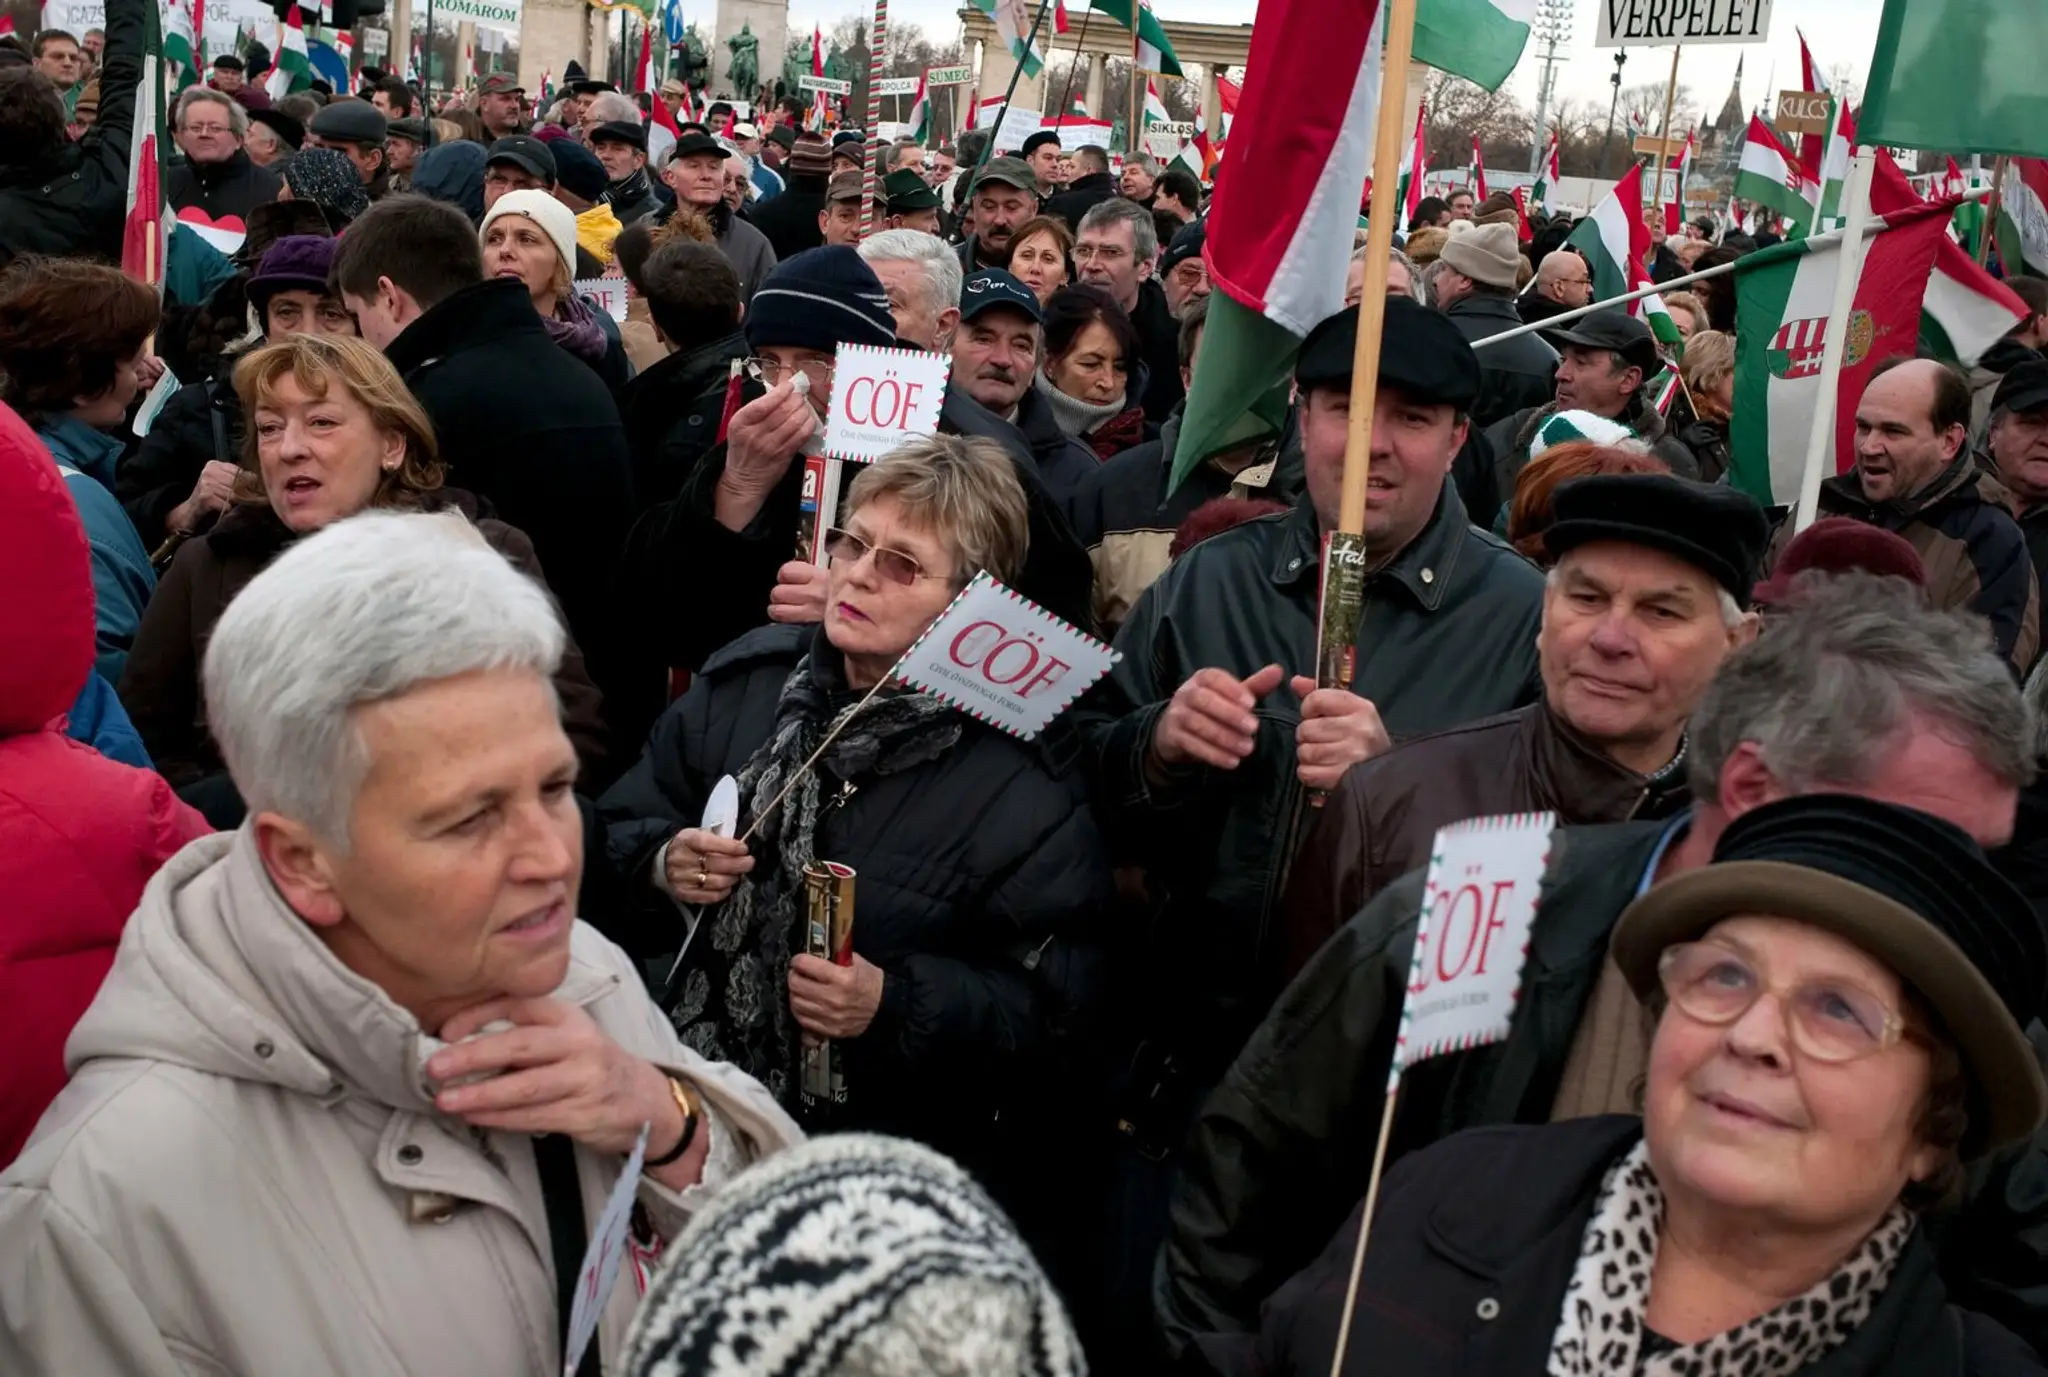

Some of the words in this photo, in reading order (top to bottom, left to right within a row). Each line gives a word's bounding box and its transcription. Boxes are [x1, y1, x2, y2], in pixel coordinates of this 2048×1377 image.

[881, 82, 911, 91] APOLCA
[1778, 96, 1830, 120] KULCS
[844, 370, 924, 431] CÖF
[949, 620, 1072, 699] CÖF
